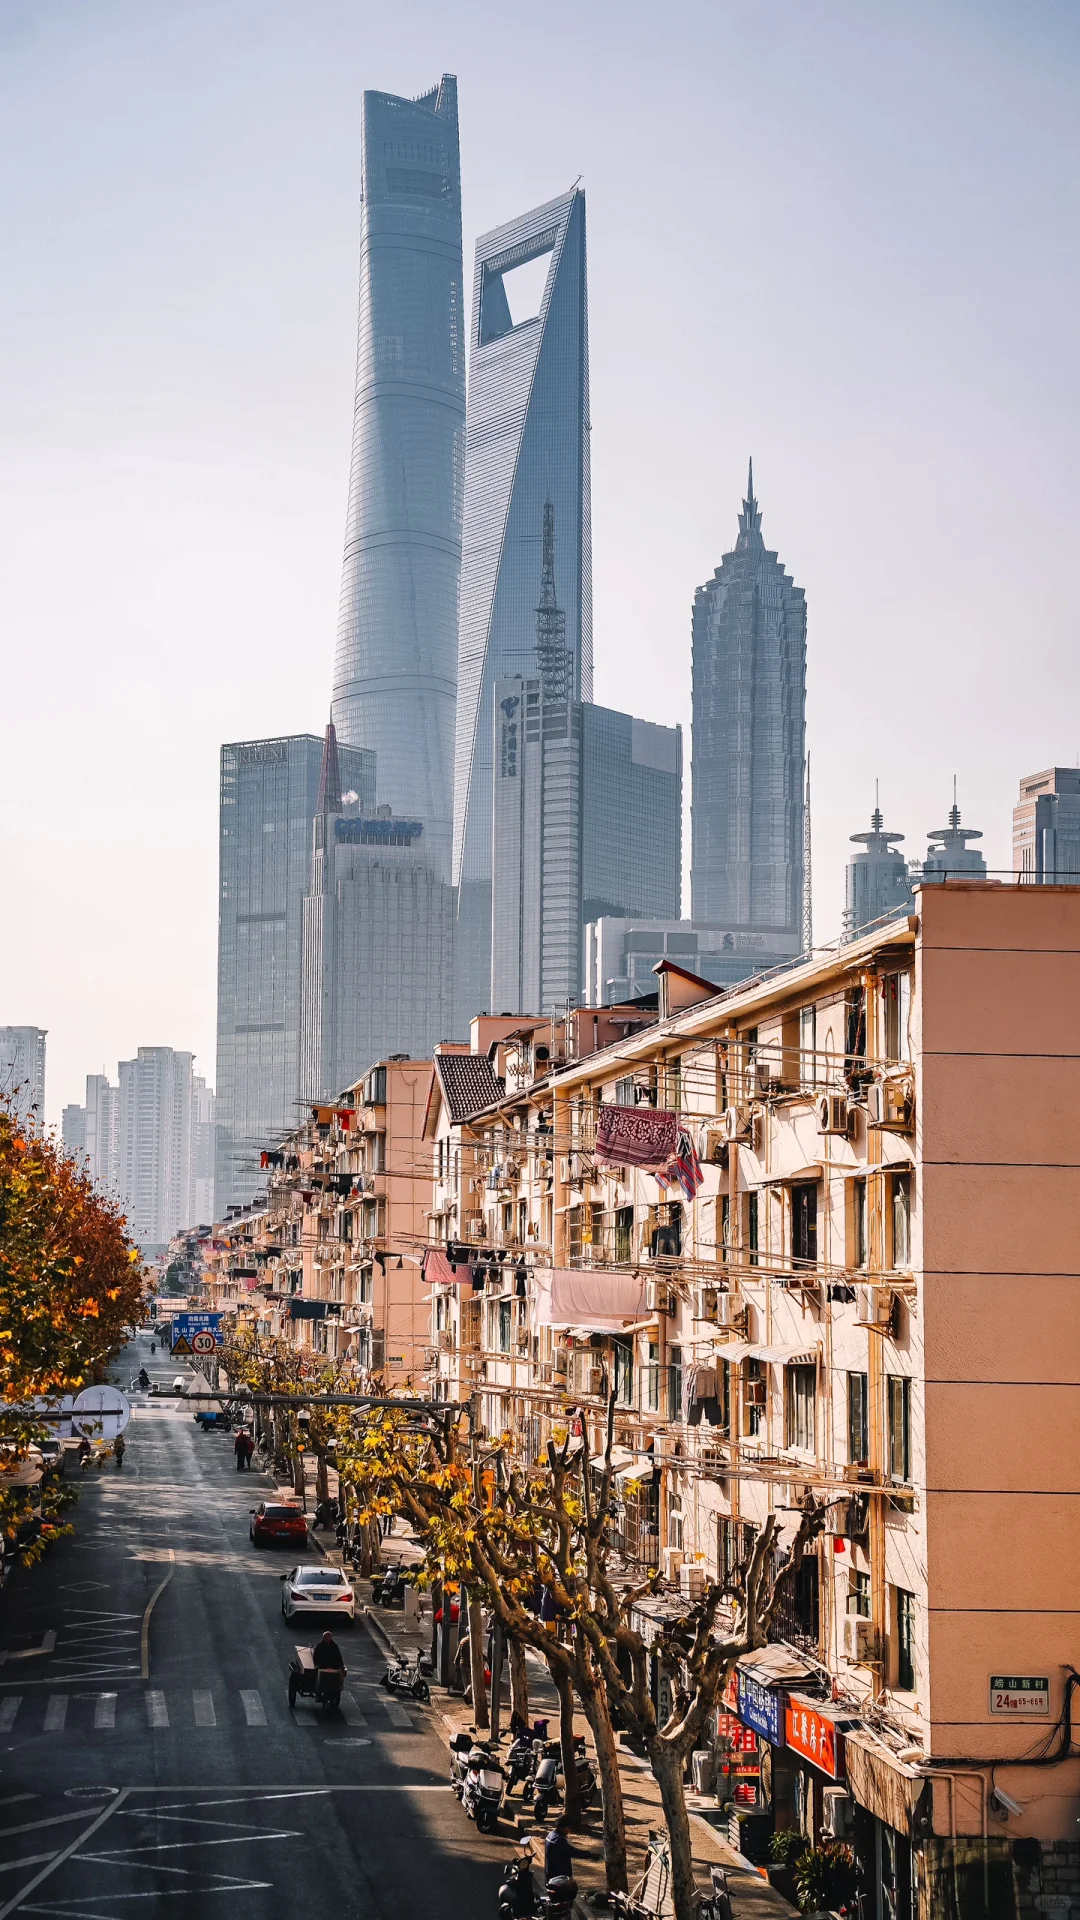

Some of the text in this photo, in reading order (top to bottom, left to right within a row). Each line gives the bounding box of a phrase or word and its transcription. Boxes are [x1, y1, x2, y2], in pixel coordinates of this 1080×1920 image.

[239, 745, 287, 763] REGENT
[197, 1337, 211, 1349] 30
[994, 1678, 1044, 1689] 崂山新村
[730, 1724, 758, 1753] 租
[792, 1709, 827, 1759] 汇聚房产
